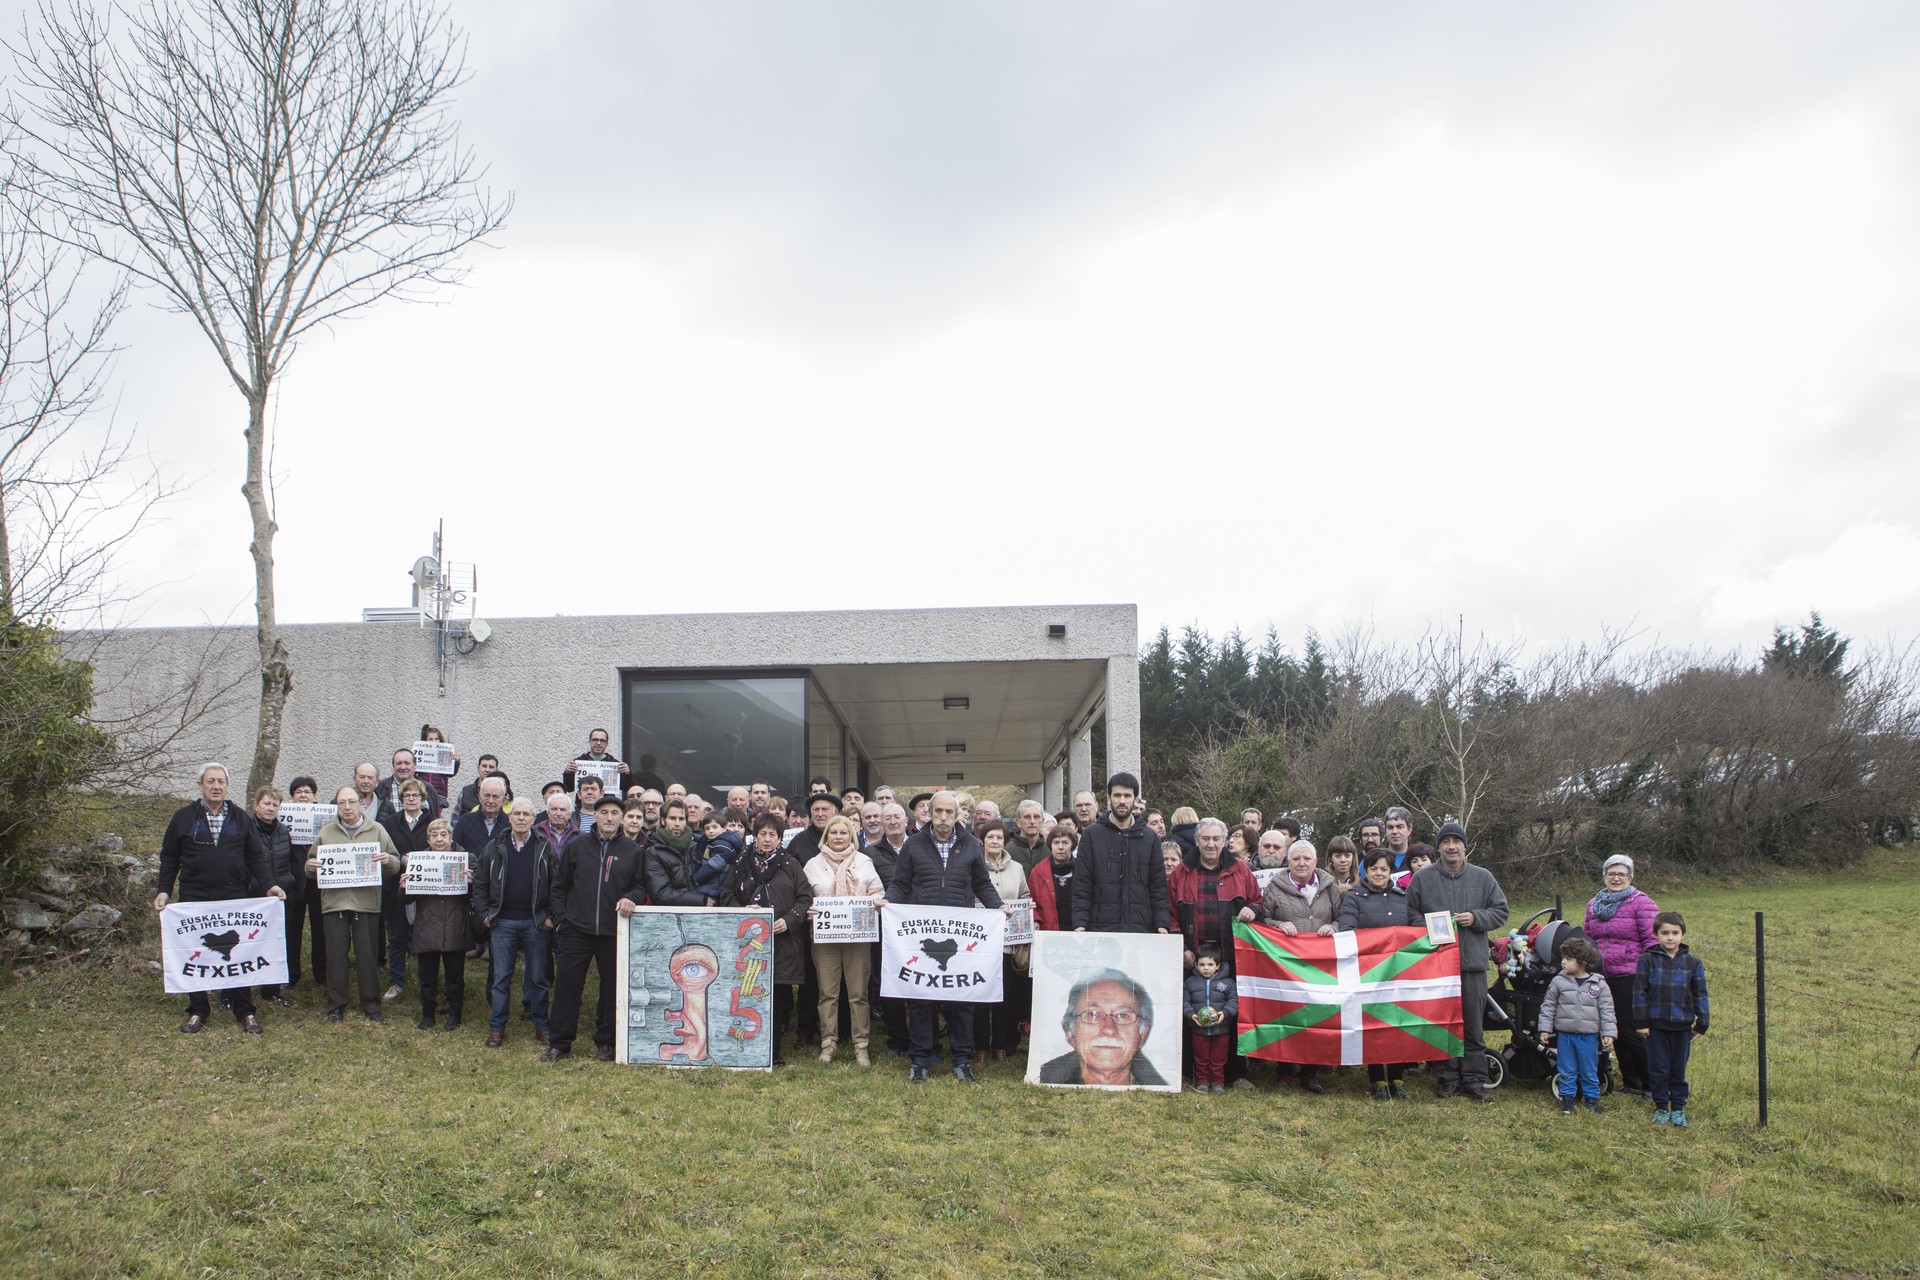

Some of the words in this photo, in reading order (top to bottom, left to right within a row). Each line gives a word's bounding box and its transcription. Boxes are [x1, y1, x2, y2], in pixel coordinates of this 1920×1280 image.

[310, 806, 335, 814] Arregi
[280, 815, 293, 823] 70
[351, 845, 378, 853] Arregi
[320, 857, 334, 866] 70
[440, 854, 466, 862] Arregi
[320, 867, 335, 876] 25
[410, 864, 423, 872] 70
[409, 874, 423, 882] 25
[1010, 901, 1030, 909] rregi
[180, 913, 224, 927] EUSKAL
[227, 912, 264, 920] PRESO
[817, 911, 831, 919] 70
[176, 925, 198, 935] ETA
[200, 919, 268, 930] IHESLARIAK
[816, 921, 831, 930] 25
[901, 919, 944, 929] EUSKAL
[948, 919, 984, 932] PRESO
[897, 927, 918, 937] ETA
[921, 926, 988, 941] IHESLARIAK
[182, 955, 271, 979] ETXERA
[898, 966, 987, 989] ETXERA
